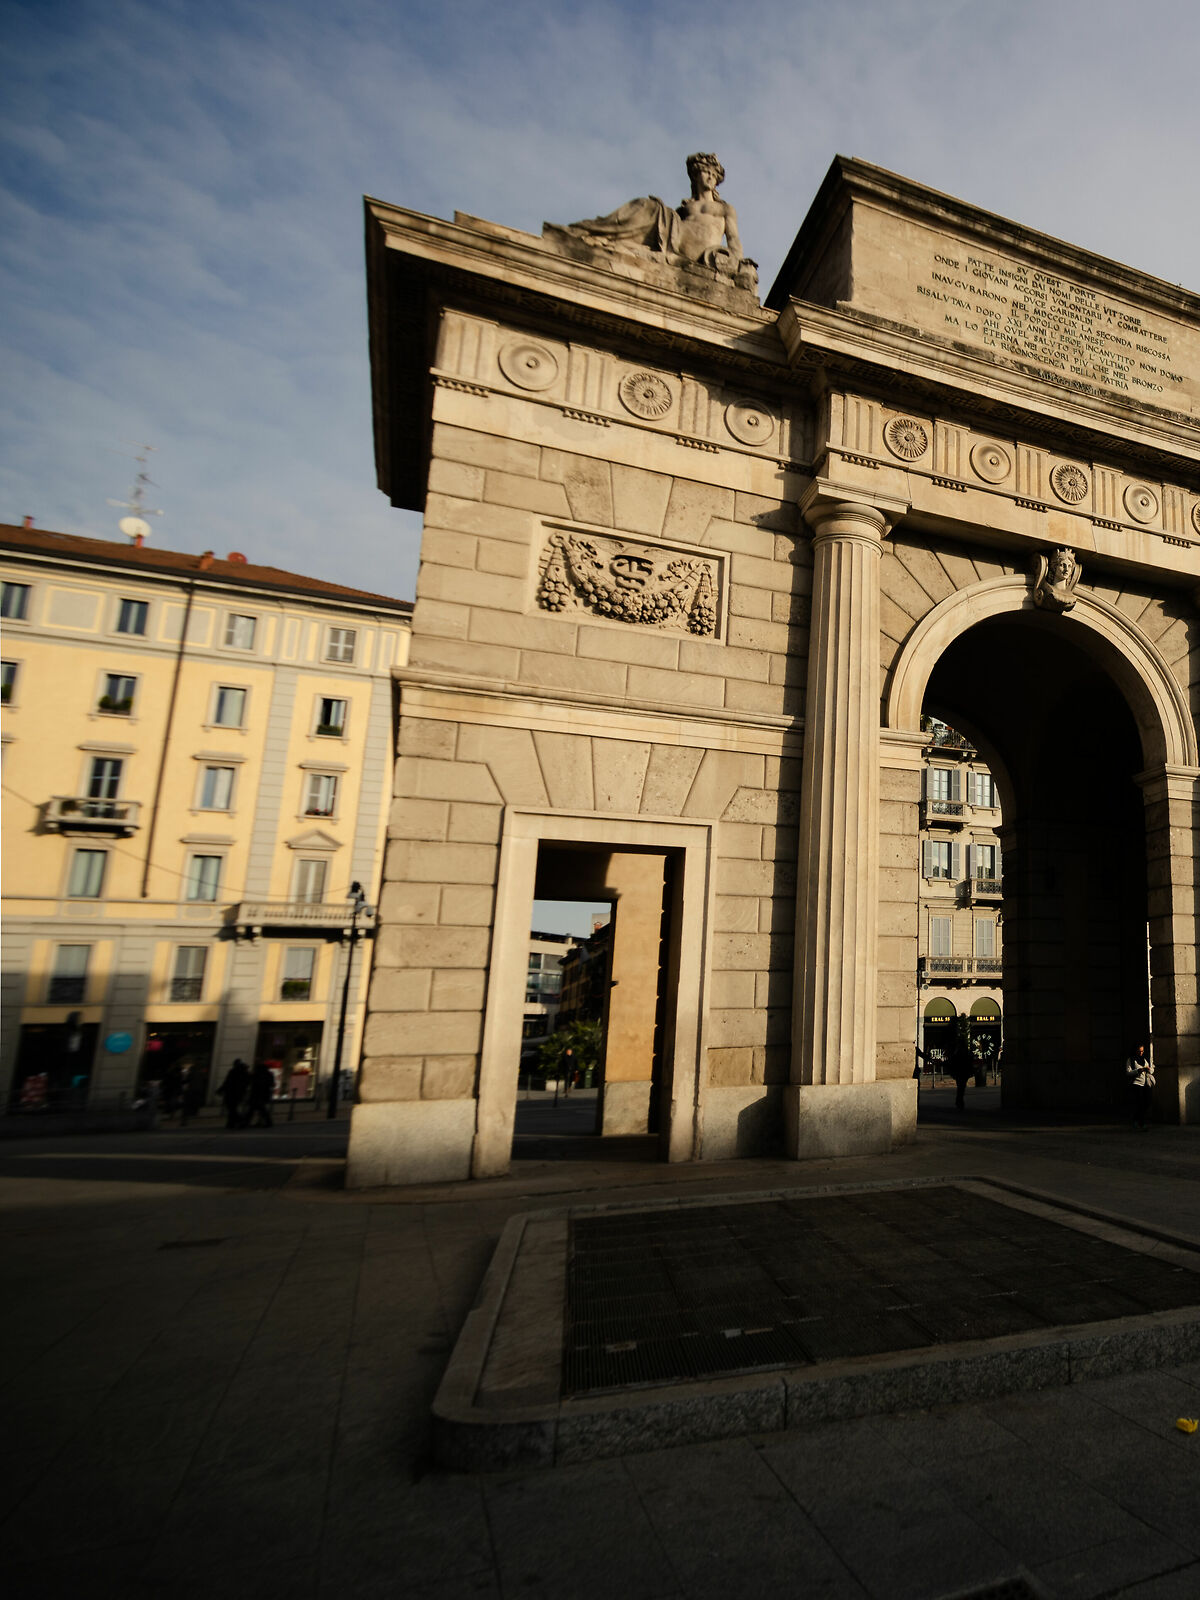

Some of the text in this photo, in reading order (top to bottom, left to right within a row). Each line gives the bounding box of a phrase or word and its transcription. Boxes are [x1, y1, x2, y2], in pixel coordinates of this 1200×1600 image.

[932, 272, 1007, 304] INAVGVRARONO
[1012, 300, 1030, 312] NEL
[1081, 324, 1092, 334] LA
[1096, 330, 1132, 348] SECONDA
[1136, 344, 1171, 362] RISCOSSA
[934, 254, 959, 268] ONDE
[972, 268, 1008, 287] GIOVANI
[1013, 284, 1048, 301] ACCORSI
[1118, 322, 1168, 344] COMBATTERE
[999, 269, 1028, 285] INSIGNI
[1032, 280, 1046, 291] DAI
[1050, 288, 1070, 300] NOMI
[1074, 296, 1100, 310] DELLE
[1104, 306, 1142, 326] VITTORIE
[1024, 296, 1046, 308] DVCE
[1070, 286, 1096, 301] PORTE
[916, 285, 971, 311] RISALVTAVA
[976, 306, 1002, 320] DOPO
[1007, 317, 1022, 328] XXI
[1027, 325, 1046, 336] ANNI
[1086, 344, 1135, 366] INCANVTITO
[1140, 362, 1157, 373] NON
[945, 314, 959, 325] MA
[965, 321, 978, 331] LO
[983, 327, 1019, 345] ETERNA
[1042, 347, 1069, 361] CVORI
[1092, 364, 1109, 374] CHE
[1113, 370, 1128, 381] NEL
[1132, 376, 1163, 392] BRONZO
[984, 318, 998, 329] AHI
[1004, 325, 1028, 338] QVEL
[1034, 336, 1069, 352] SALVTO
[1100, 357, 1130, 373] VLTIMO
[1024, 314, 1060, 331] POPOLO
[1064, 327, 1104, 346] MILANESE
[984, 337, 996, 346] LA
[1001, 342, 1064, 370] RICONOSCENZA
[1070, 364, 1096, 380] DELLA
[1101, 375, 1129, 390] PATRIA
